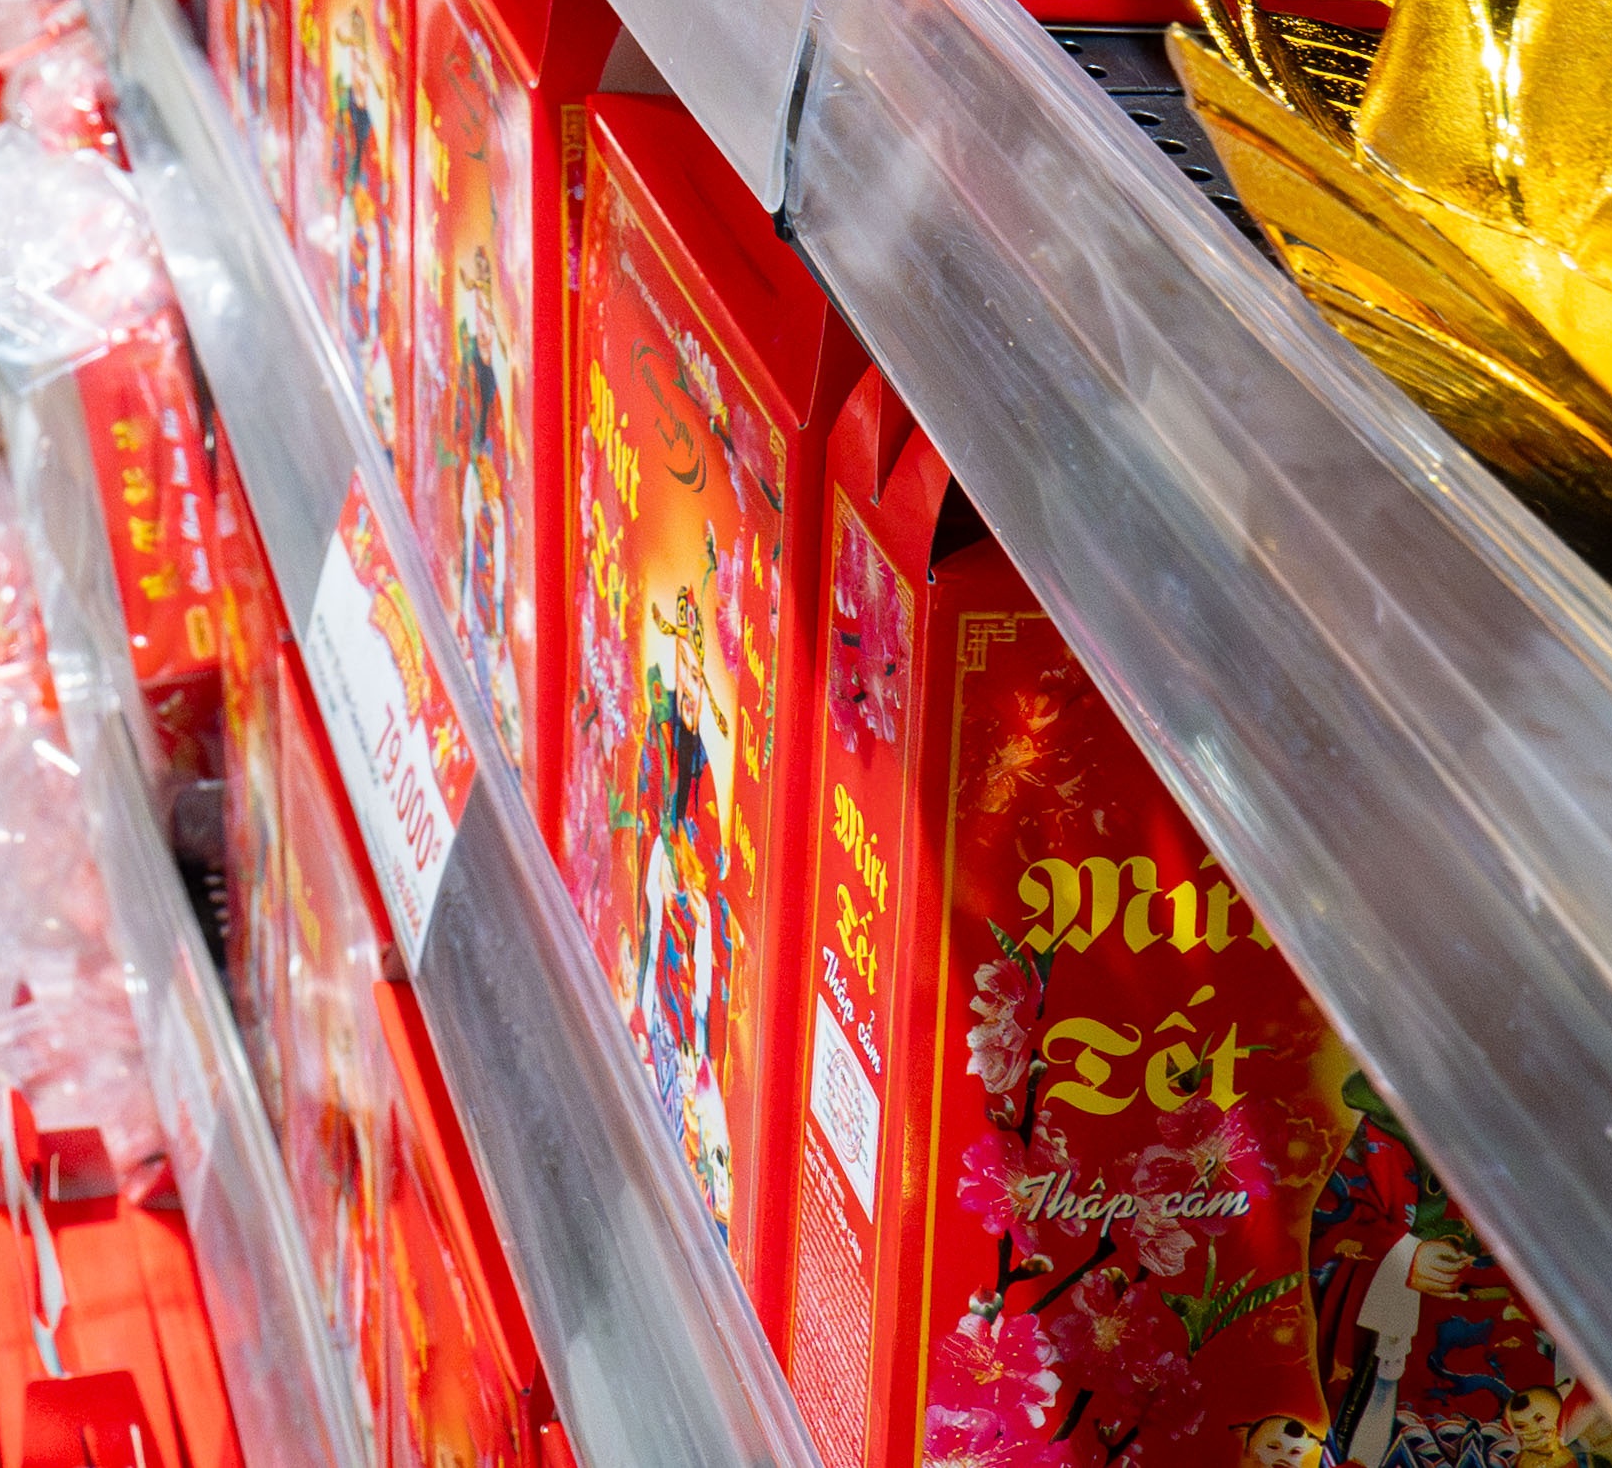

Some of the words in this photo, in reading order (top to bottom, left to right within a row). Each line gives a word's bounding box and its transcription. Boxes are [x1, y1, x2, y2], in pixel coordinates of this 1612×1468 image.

[589, 358, 641, 522] Mứt
[833, 782, 889, 914] Mứt
[835, 883, 879, 996] Tết
[1041, 984, 1250, 1116] Tết
[1019, 1168, 1138, 1239] Thập
[1161, 1157, 1251, 1219] cẩm
